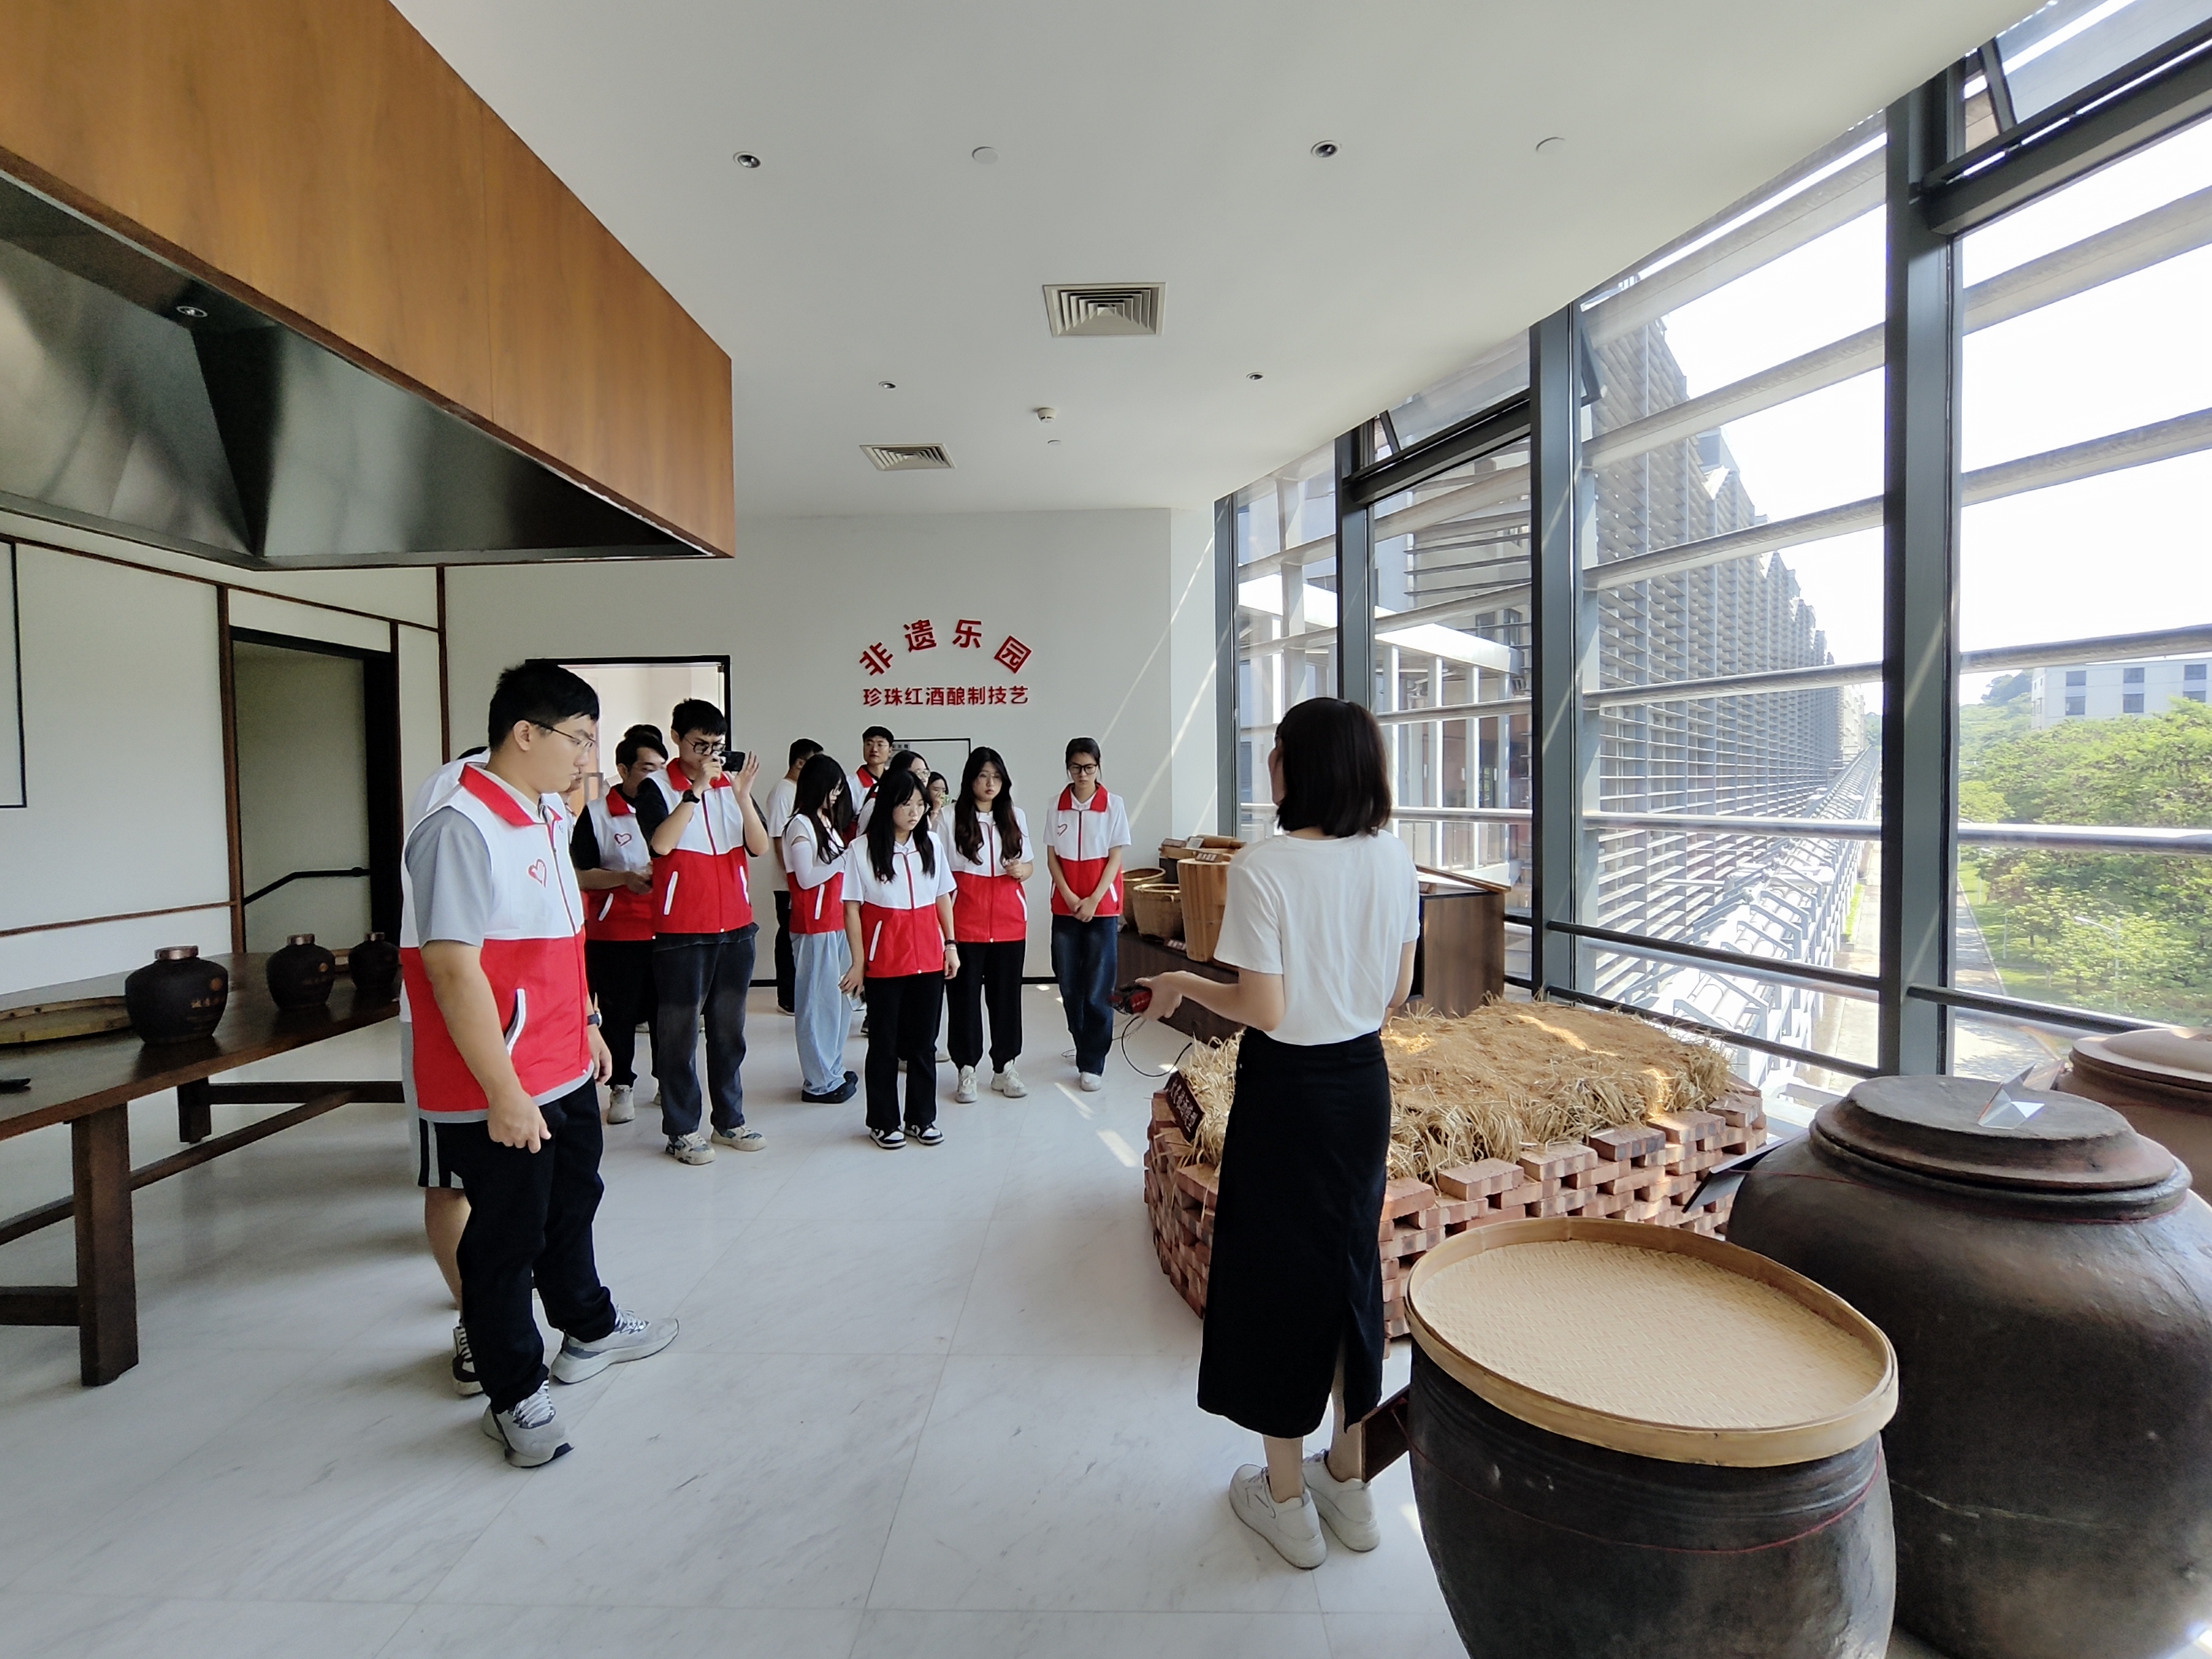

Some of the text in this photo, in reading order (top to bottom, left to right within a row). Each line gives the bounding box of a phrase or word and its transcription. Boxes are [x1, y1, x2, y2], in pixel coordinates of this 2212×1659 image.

[859, 619, 1032, 676] 非遗乐园
[863, 686, 1029, 706] 珍珠红酒酿制技艺
